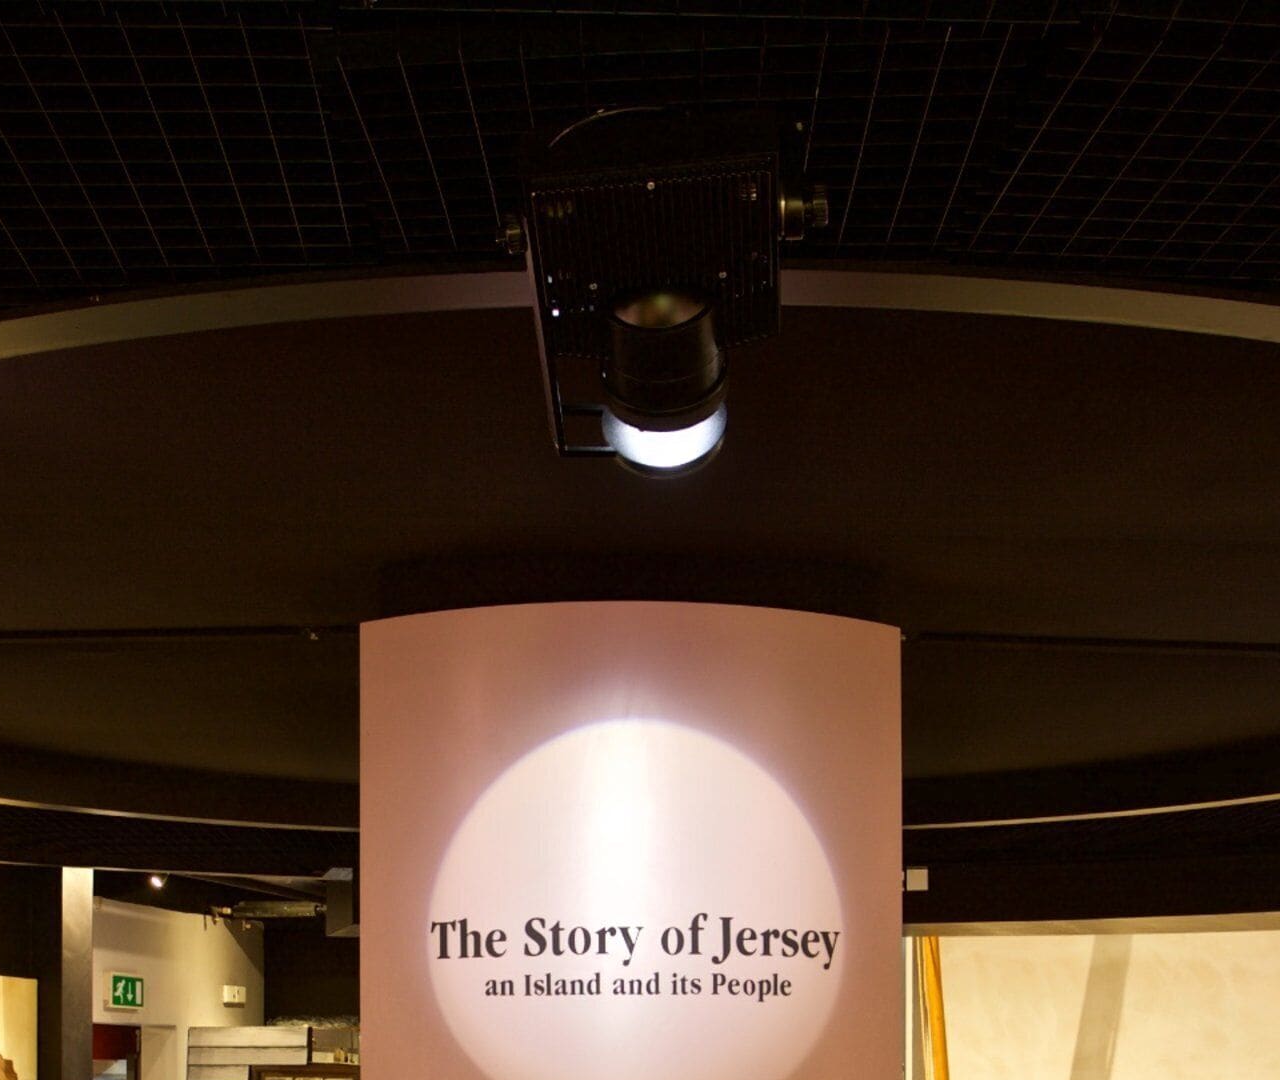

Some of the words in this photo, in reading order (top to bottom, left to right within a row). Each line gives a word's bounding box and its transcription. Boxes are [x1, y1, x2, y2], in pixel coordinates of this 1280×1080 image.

[430, 918, 508, 959] The
[523, 917, 643, 966] Story
[661, 912, 708, 955] of
[711, 916, 840, 970] Jersey
[485, 979, 515, 996] an
[524, 972, 601, 996] Island
[612, 972, 660, 996] and
[671, 972, 702, 995] its
[711, 972, 792, 1003] People
